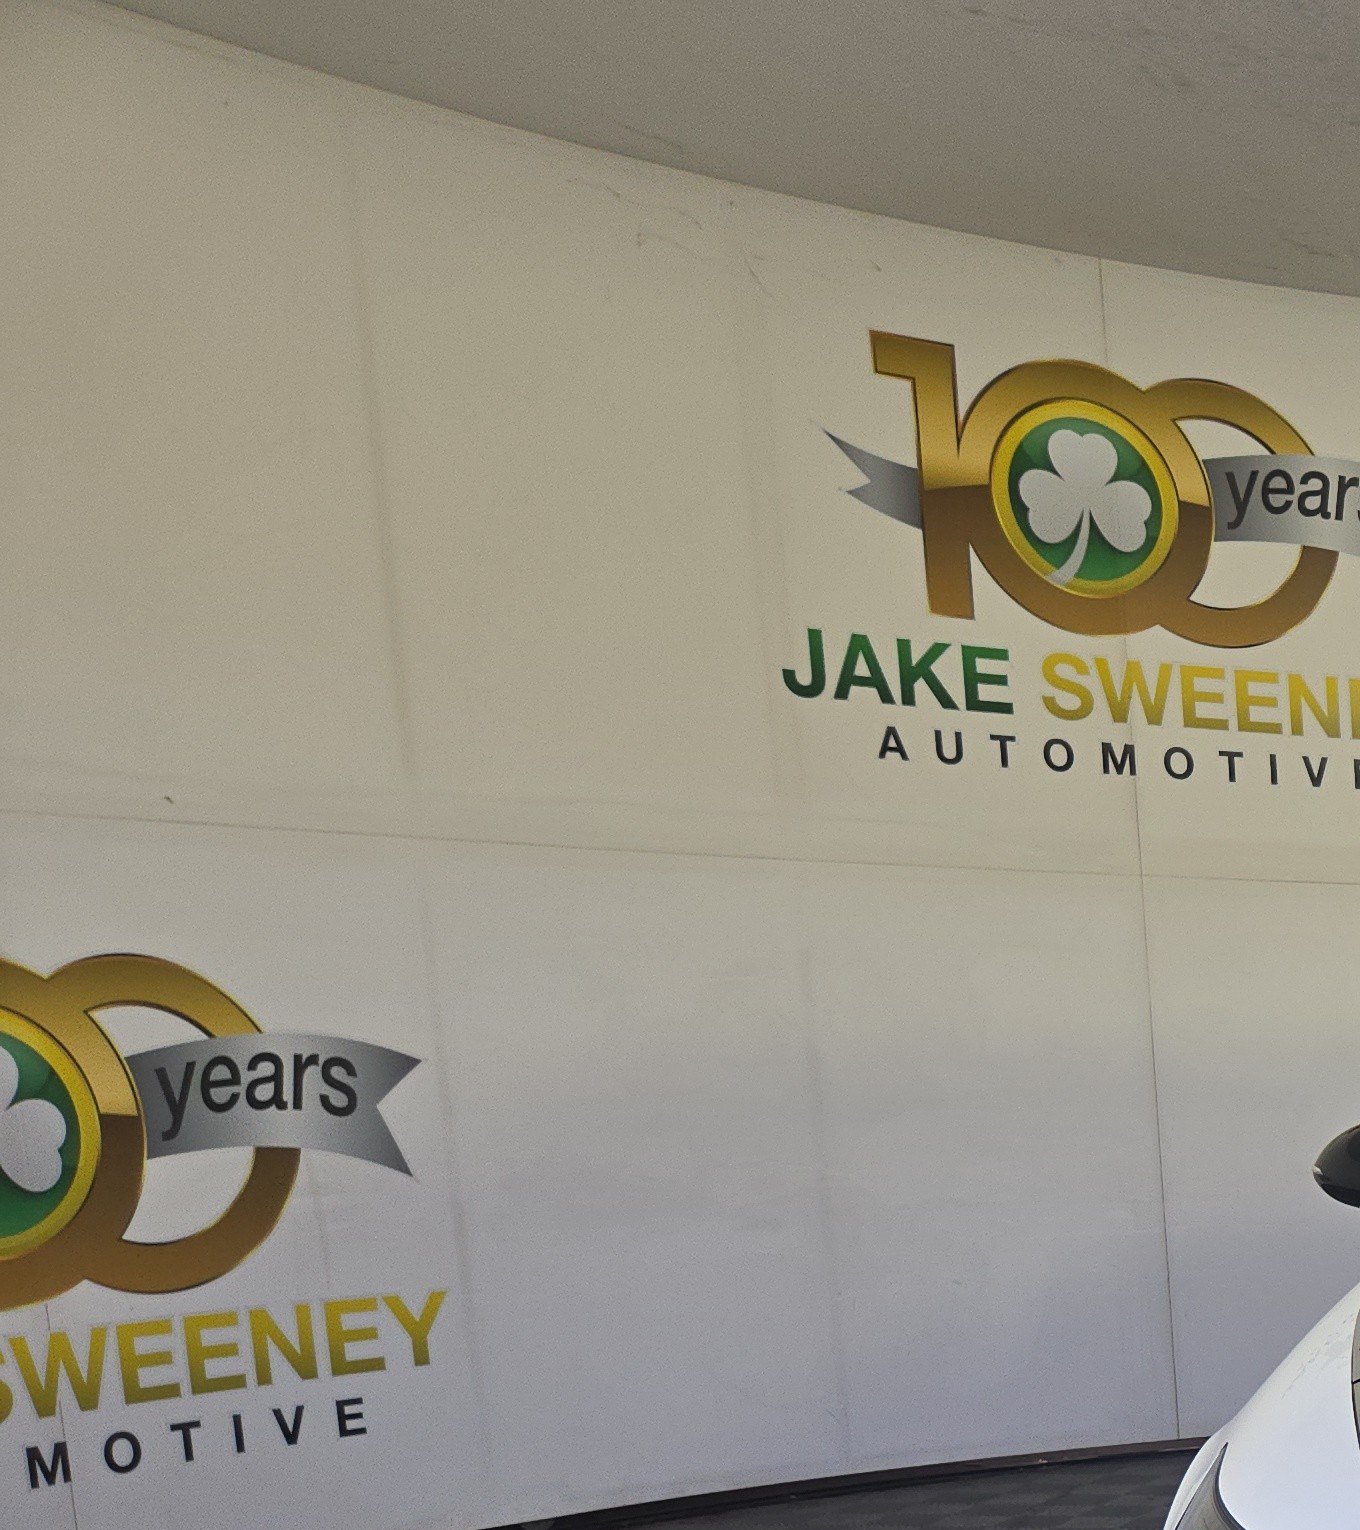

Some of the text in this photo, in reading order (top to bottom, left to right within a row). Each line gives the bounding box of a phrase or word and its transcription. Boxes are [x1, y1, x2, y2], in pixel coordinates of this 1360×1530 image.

[781, 627, 1015, 715] JAKE
[153, 1050, 359, 1141] years
[0, 1289, 448, 1424] WEENEY
[24, 1397, 368, 1490] MOTIVE
